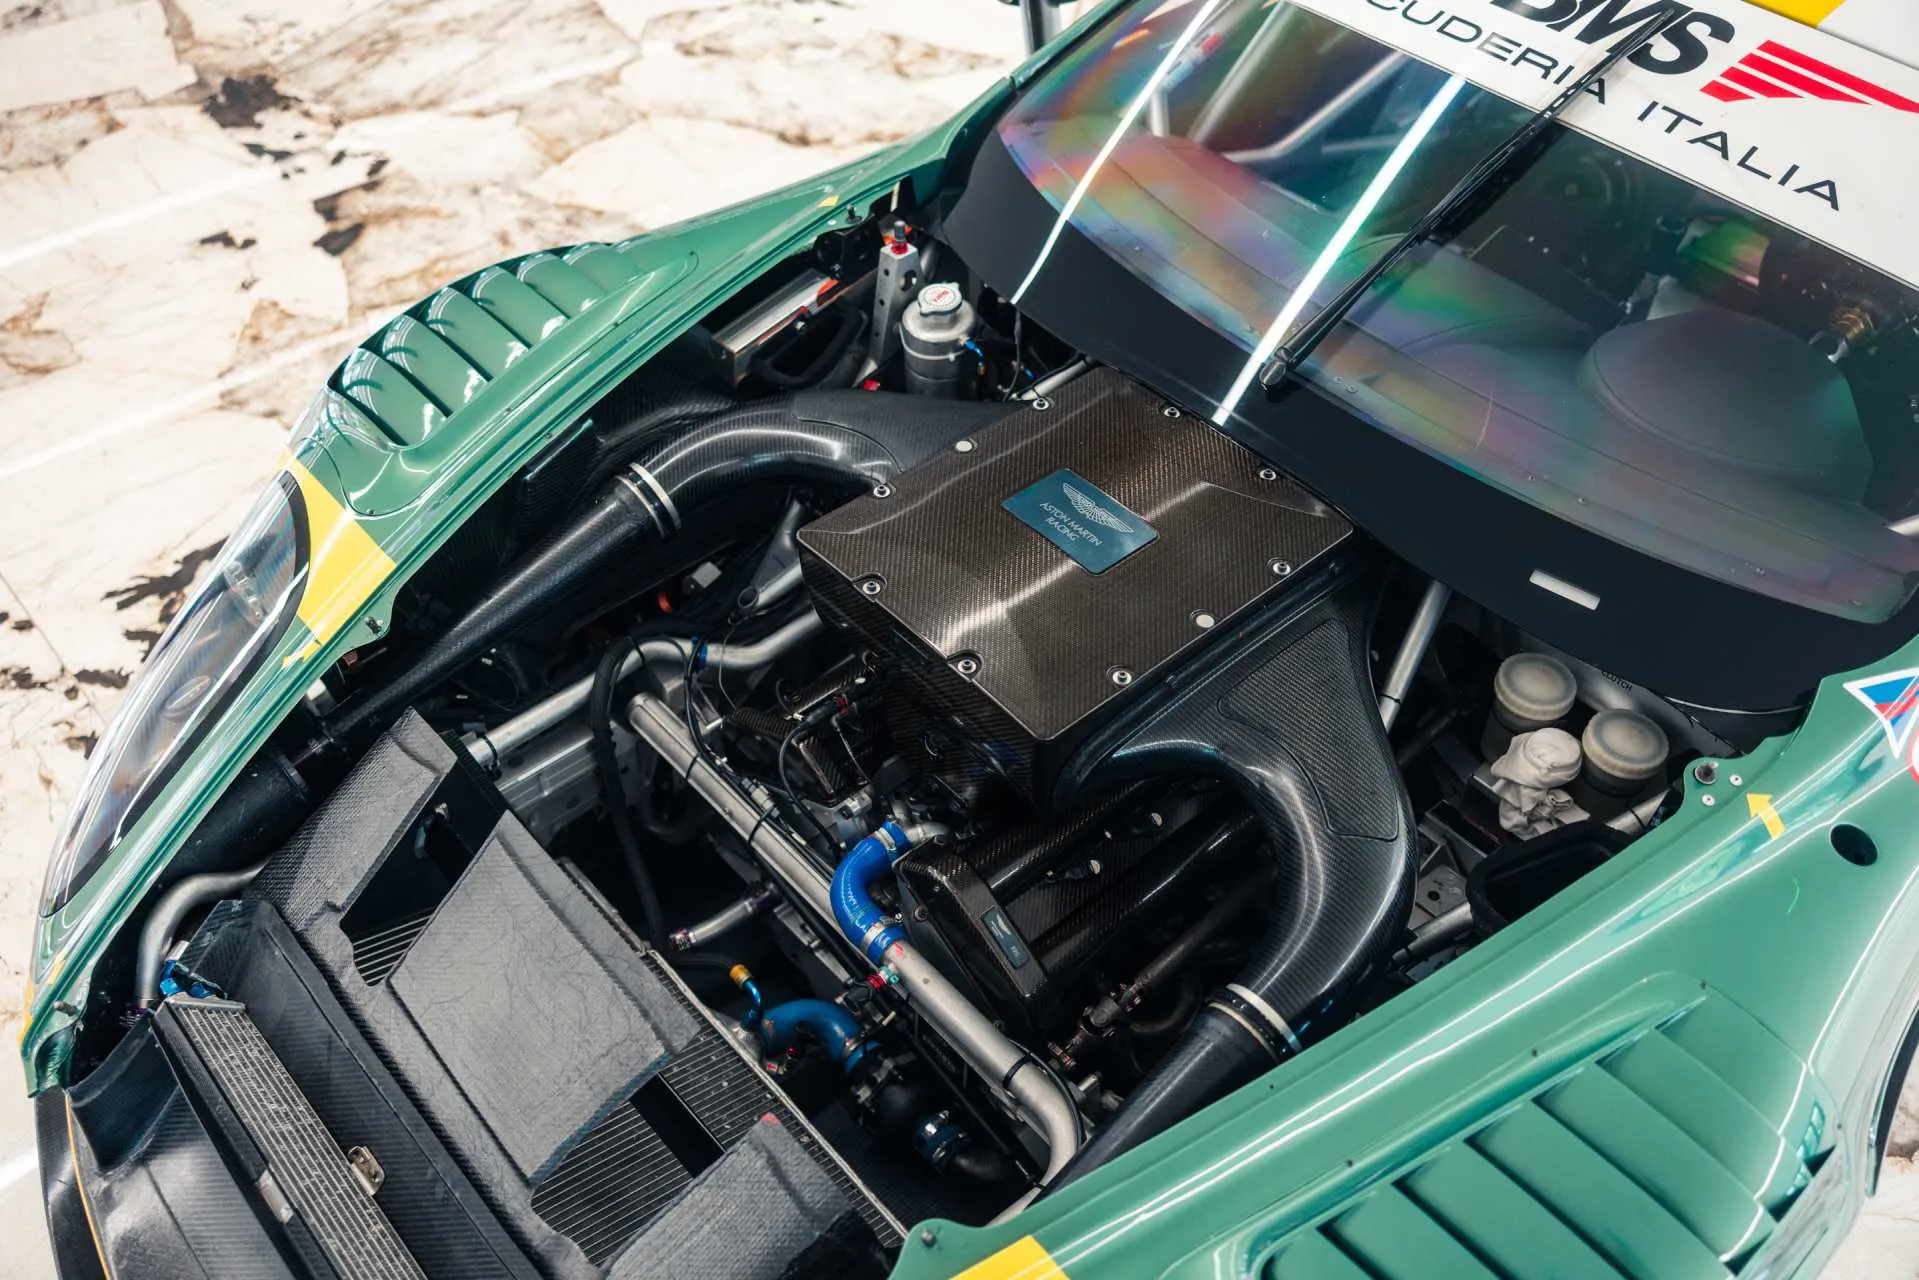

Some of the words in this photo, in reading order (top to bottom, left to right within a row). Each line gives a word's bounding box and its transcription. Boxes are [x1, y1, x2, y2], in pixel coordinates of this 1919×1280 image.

[1637, 101, 1840, 212] ITALIA
[1040, 503, 1071, 522] ASTON
[1068, 521, 1103, 546] MARTIN
[1045, 516, 1079, 541] RACING
